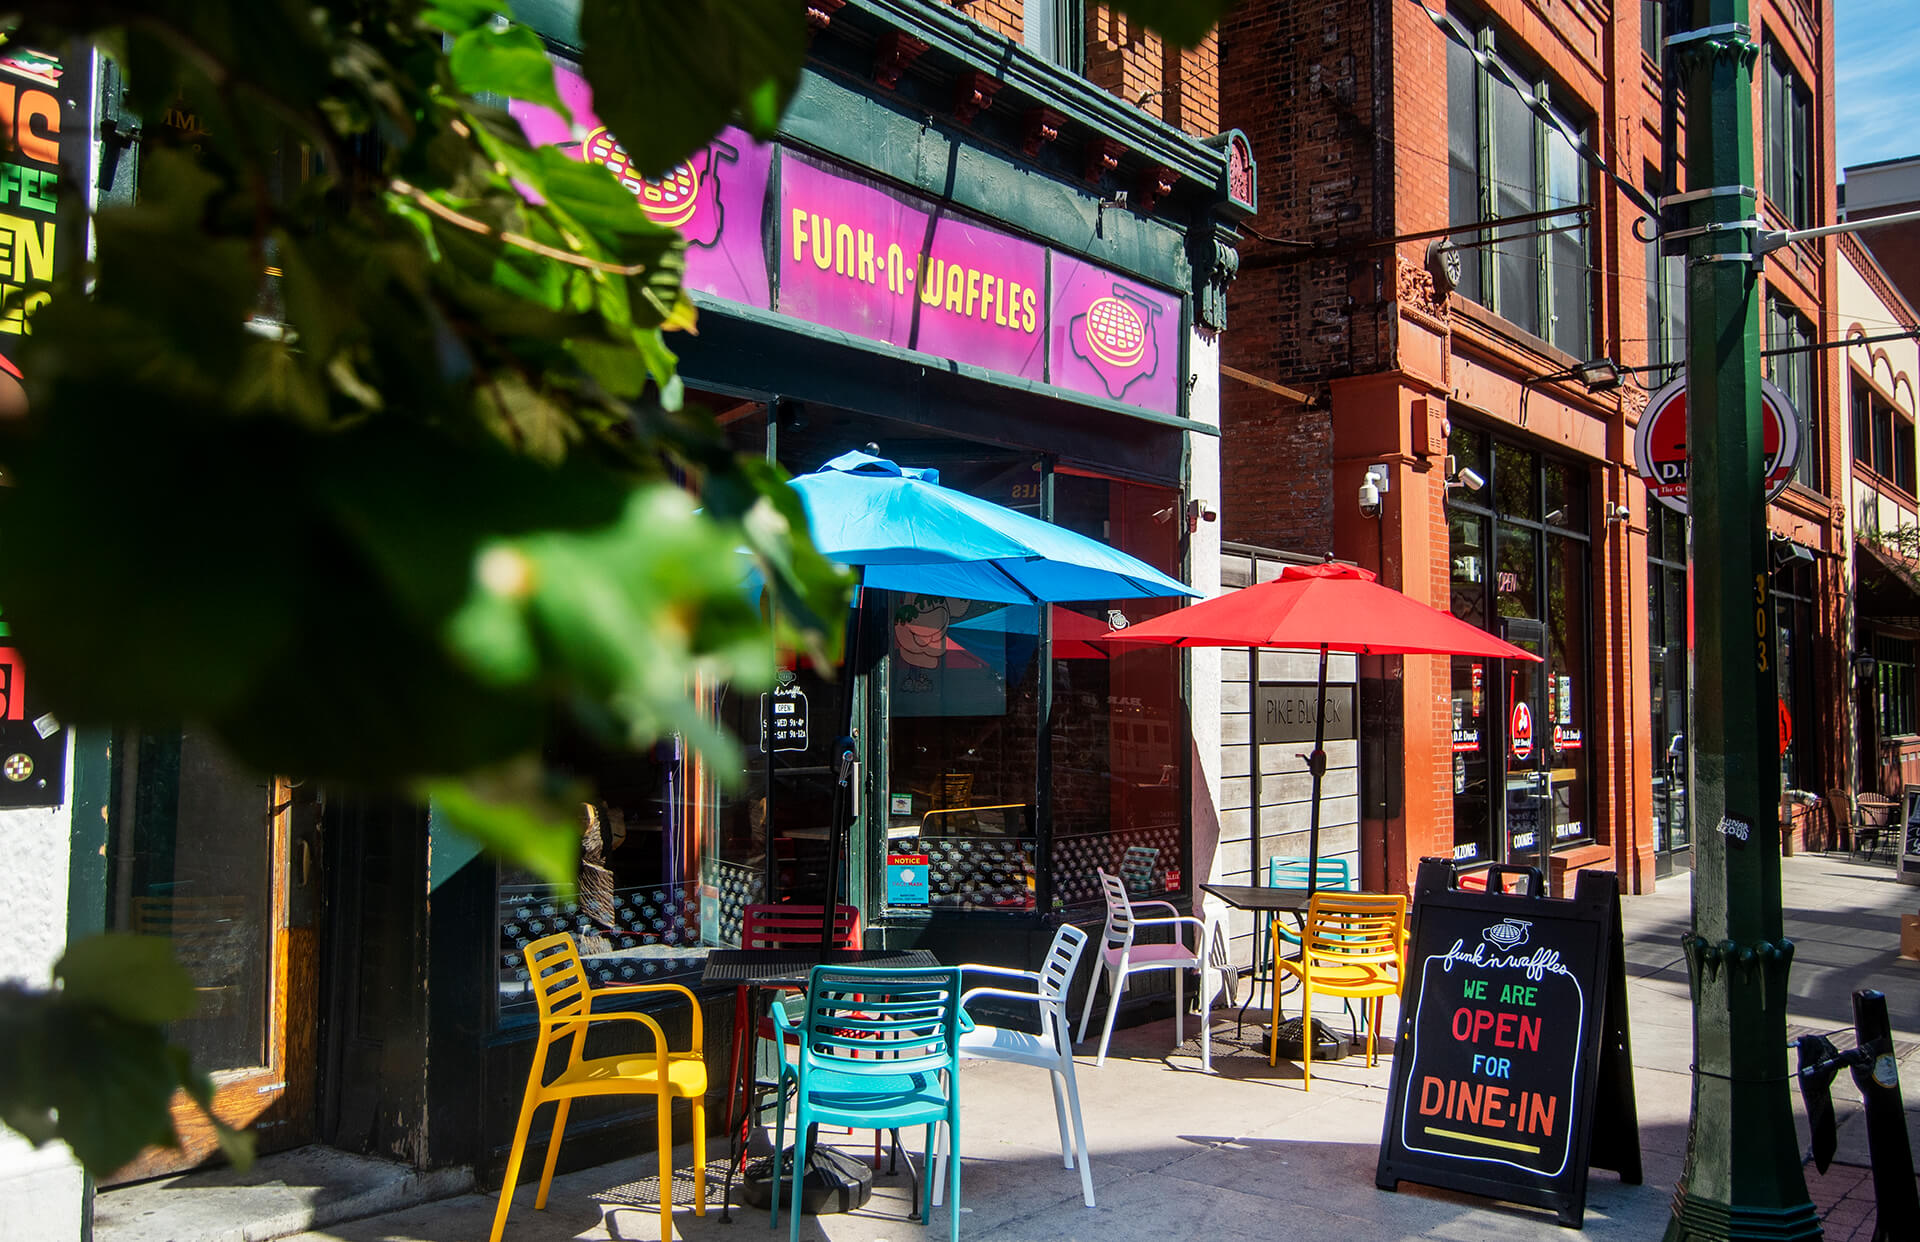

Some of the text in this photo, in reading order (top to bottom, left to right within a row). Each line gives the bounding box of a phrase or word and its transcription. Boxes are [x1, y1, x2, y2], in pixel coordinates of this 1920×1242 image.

[1498, 572, 1518, 592] OPEN
[1266, 699, 1293, 725] PIKE
[894, 857, 921, 865] NOTICE
[1443, 938, 1486, 972] funk
[1506, 946, 1567, 982] waffles
[1463, 979, 1538, 1007] WE ARE
[1452, 1007, 1542, 1052] OPEN
[1472, 1054, 1511, 1079] FOR
